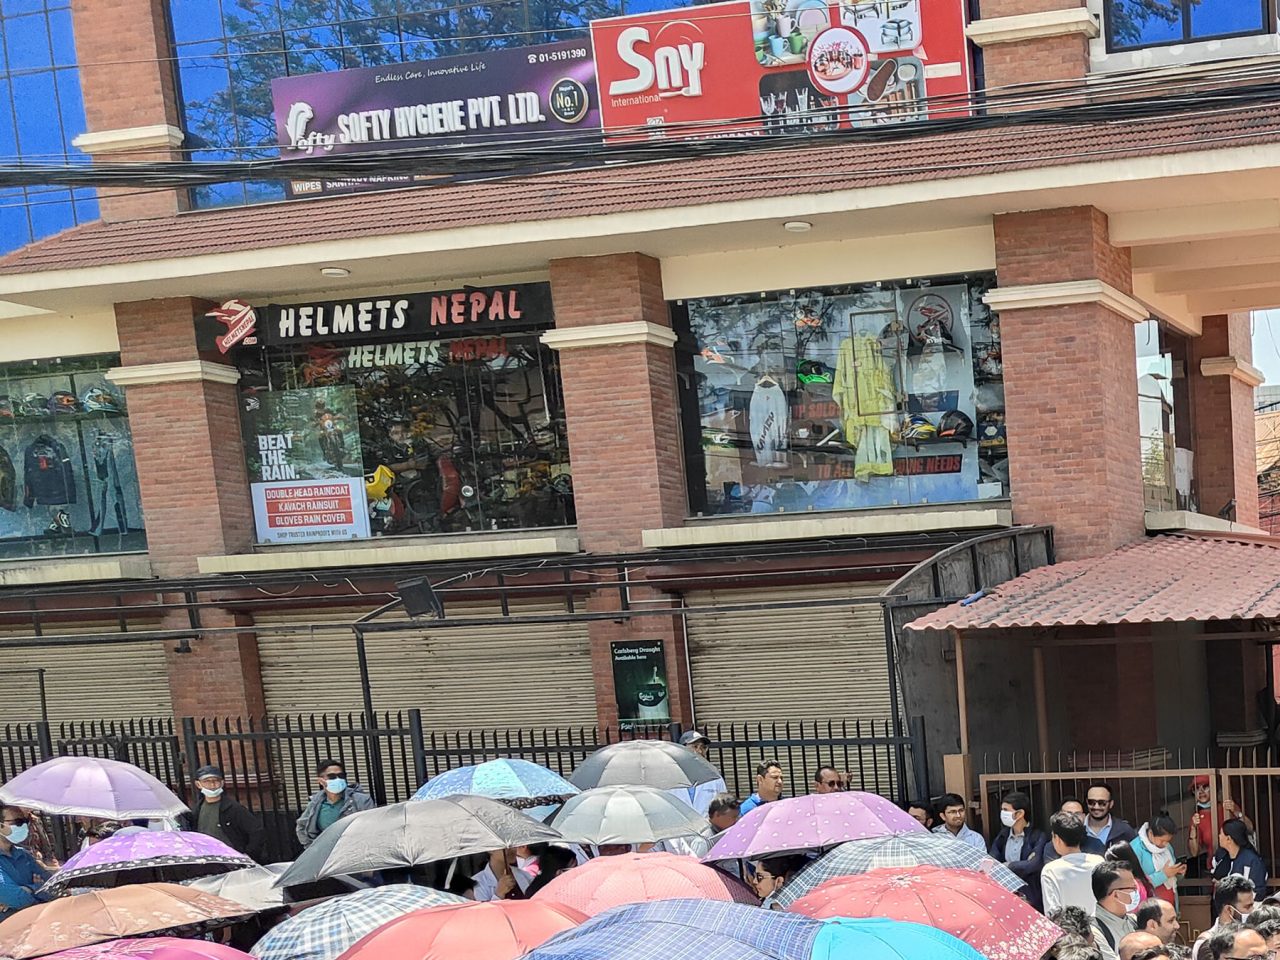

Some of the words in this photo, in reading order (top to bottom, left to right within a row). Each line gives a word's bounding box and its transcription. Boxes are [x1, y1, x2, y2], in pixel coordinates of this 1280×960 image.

[538, 48, 587, 63] 01-5191390
[375, 72, 403, 84] Endless
[427, 65, 469, 77] Innovative
[470, 62, 486, 72] Life
[611, 95, 662, 107] International
[337, 109, 391, 144] SOFTY
[393, 100, 467, 138] HYGIENE
[467, 95, 507, 129] PVT.
[508, 91, 546, 124] LTD.
[294, 181, 322, 192] WIPES
[279, 299, 409, 338] HELMETS
[430, 290, 523, 326] NEPAL
[348, 340, 440, 369] HELMETS
[257, 432, 294, 451] BEAT
[259, 449, 287, 466] THE
[261, 464, 300, 481] RAIN.
[266, 487, 293, 499] DOUBLE
[293, 486, 313, 498] HEAD
[313, 485, 349, 496] RAINCOAT
[278, 501, 306, 512] KAVACH
[306, 500, 339, 511] RAINSUIT
[275, 515, 303, 526] GLOVES
[304, 514, 322, 524] RAIN
[322, 512, 346, 523] COVER
